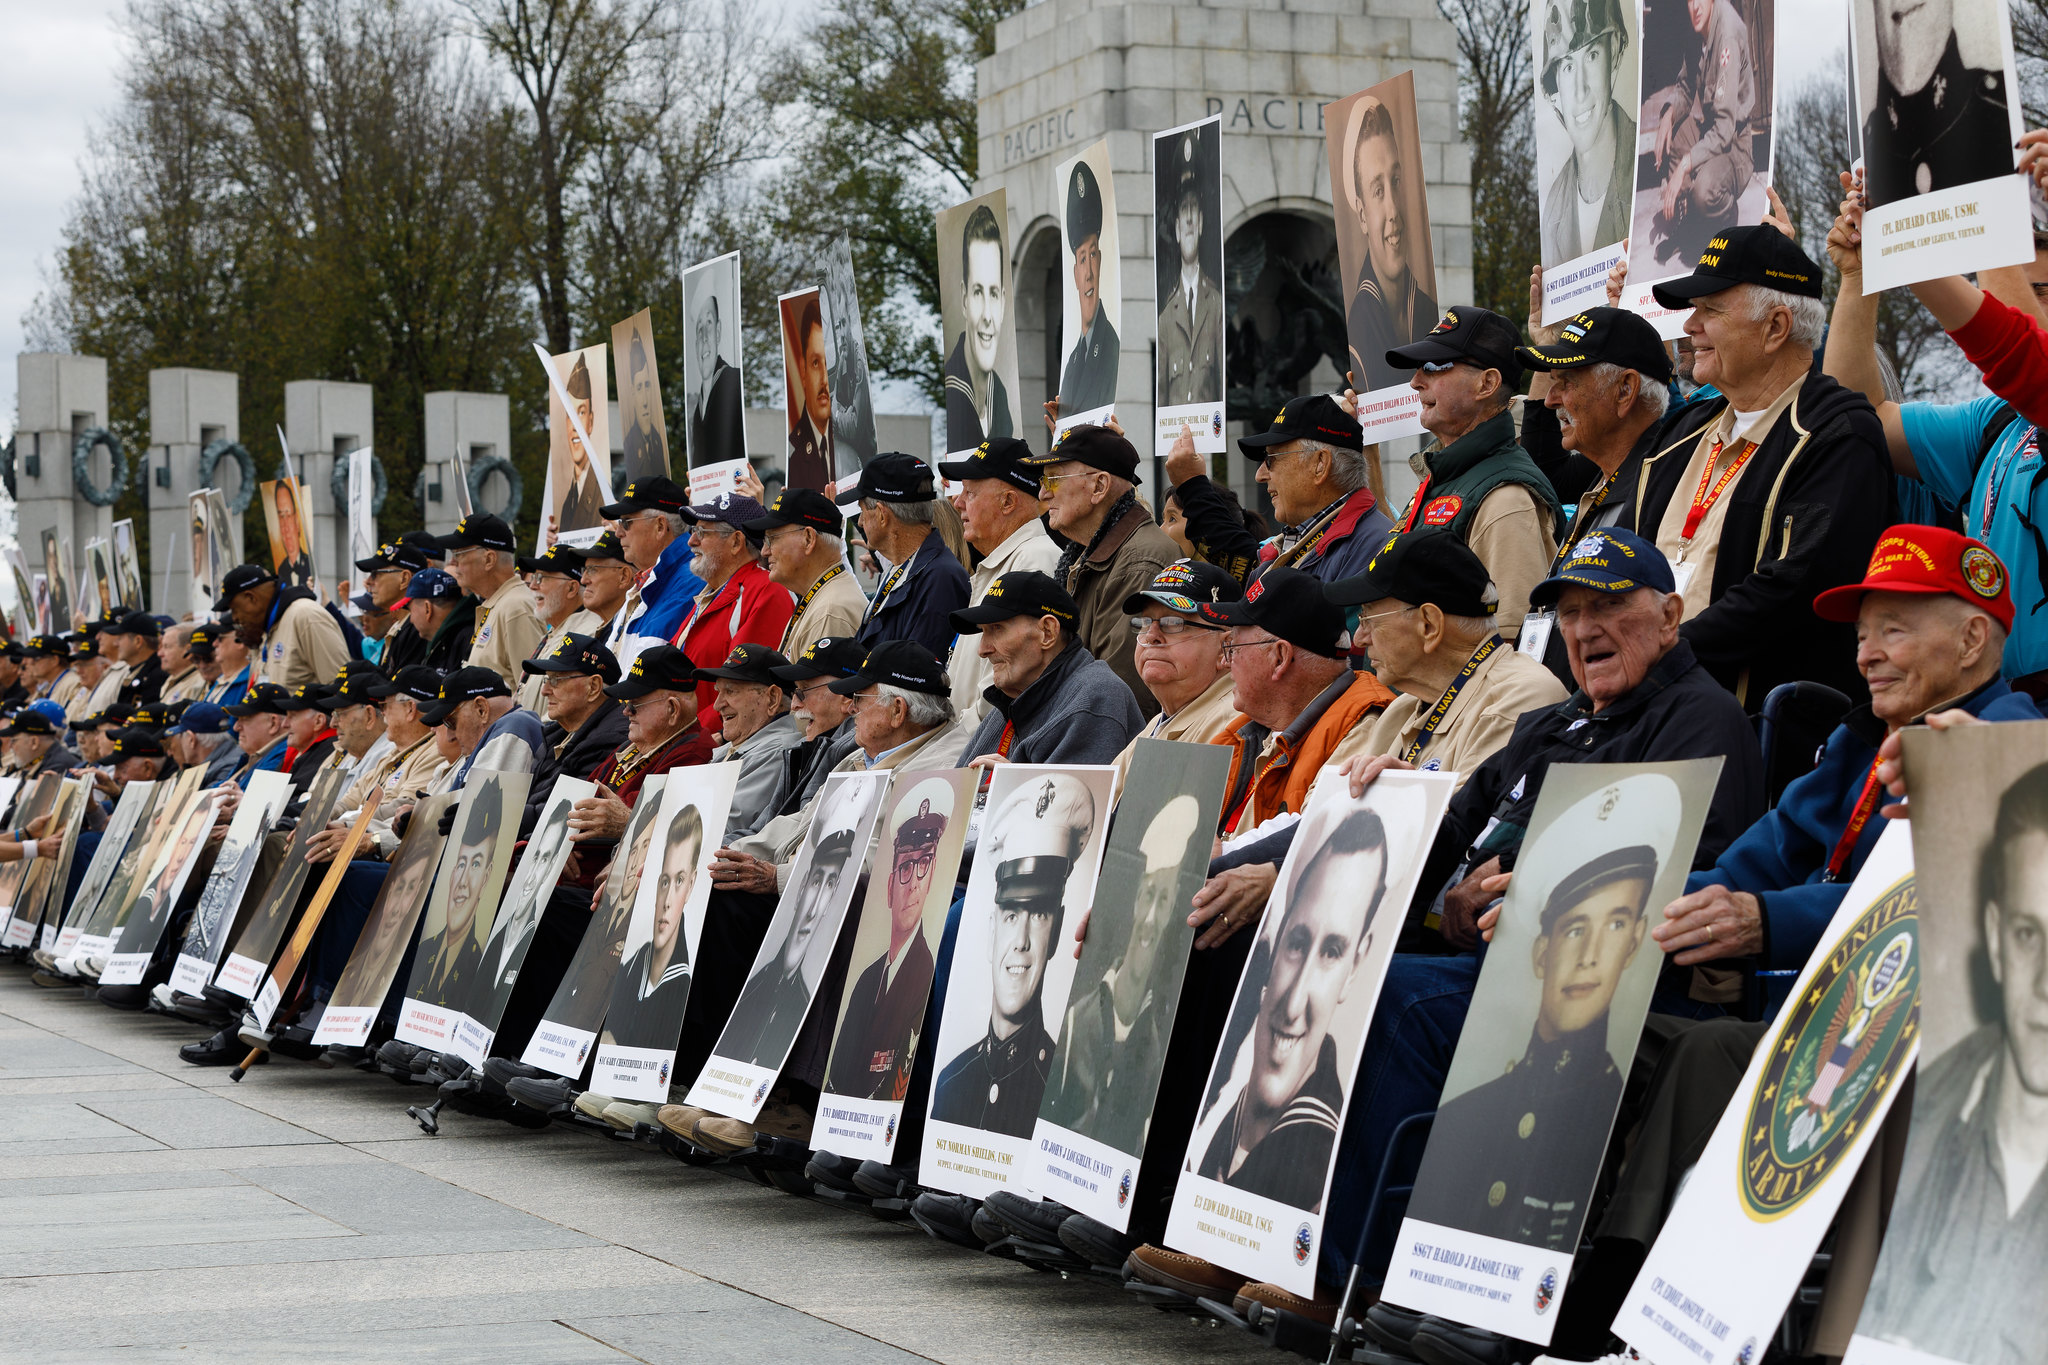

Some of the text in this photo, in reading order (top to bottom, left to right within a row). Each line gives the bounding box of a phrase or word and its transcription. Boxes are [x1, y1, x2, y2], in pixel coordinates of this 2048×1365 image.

[1003, 109, 1075, 163] PACIFIC
[1895, 214, 1925, 232] RICHARD
[1926, 207, 1953, 225] CRAIG,
[1954, 202, 1979, 219] USMC
[1917, 236, 1931, 248] CAMP
[1958, 225, 1985, 239] VIETNAM
[1550, 280, 1558, 292] SGT
[1558, 272, 1579, 288] CHARLES
[1766, 269, 1809, 282] Indy Honor Flight
[1546, 354, 1586, 364] VETERAN
[1703, 495, 1717, 509] U.S.
[1713, 461, 1741, 495] MARINE
[1604, 534, 1636, 558] GUARD
[1880, 537, 1905, 550] CORPS
[1905, 541, 1936, 571] VETERAN
[1885, 553, 1904, 563] WAR
[1905, 553, 1913, 561] II
[1168, 569, 1195, 583] VETERANS
[1562, 556, 1609, 572] VETERAN
[882, 578, 896, 596] NAVY
[1560, 574, 1607, 589] PROUDLY
[1041, 604, 1051, 613] Indy
[1462, 640, 1496, 677] U.S. NAVY
[891, 671, 901, 679] Indy
[1425, 685, 1459, 732] U.S. NAVY
[623, 770, 638, 783] ARMY
[1831, 885, 1919, 974] UNITE
[831, 1108, 849, 1121] ROBERT
[936, 1138, 1014, 1167] SGT NORMAN SHIELDS, USMC
[1040, 1138, 1048, 1151] CB
[1048, 1141, 1062, 1158] JOHN
[1066, 1148, 1093, 1173] LOUGHLIN,
[1092, 1159, 1101, 1173] US
[1099, 1162, 1114, 1179] NAVY
[952, 1162, 964, 1173] CAMP
[981, 1168, 998, 1180] VIETNAM
[998, 1172, 1007, 1183] WAR
[1749, 1147, 1810, 1203] ARMY
[1194, 1194, 1274, 1234] E3 EDWARD BAKER, USCG
[1196, 1220, 1218, 1238] FIREMAN,
[1217, 1226, 1227, 1239] USS
[1249, 1238, 1261, 1252] WWII
[1412, 1242, 1524, 1282] SSGT HAROLD J BASORE USMC
[1409, 1268, 1423, 1281] WWII
[1423, 1271, 1443, 1286] MARINE
[1443, 1276, 1468, 1292] AVIATION
[1467, 1282, 1487, 1297] SUPPLY
